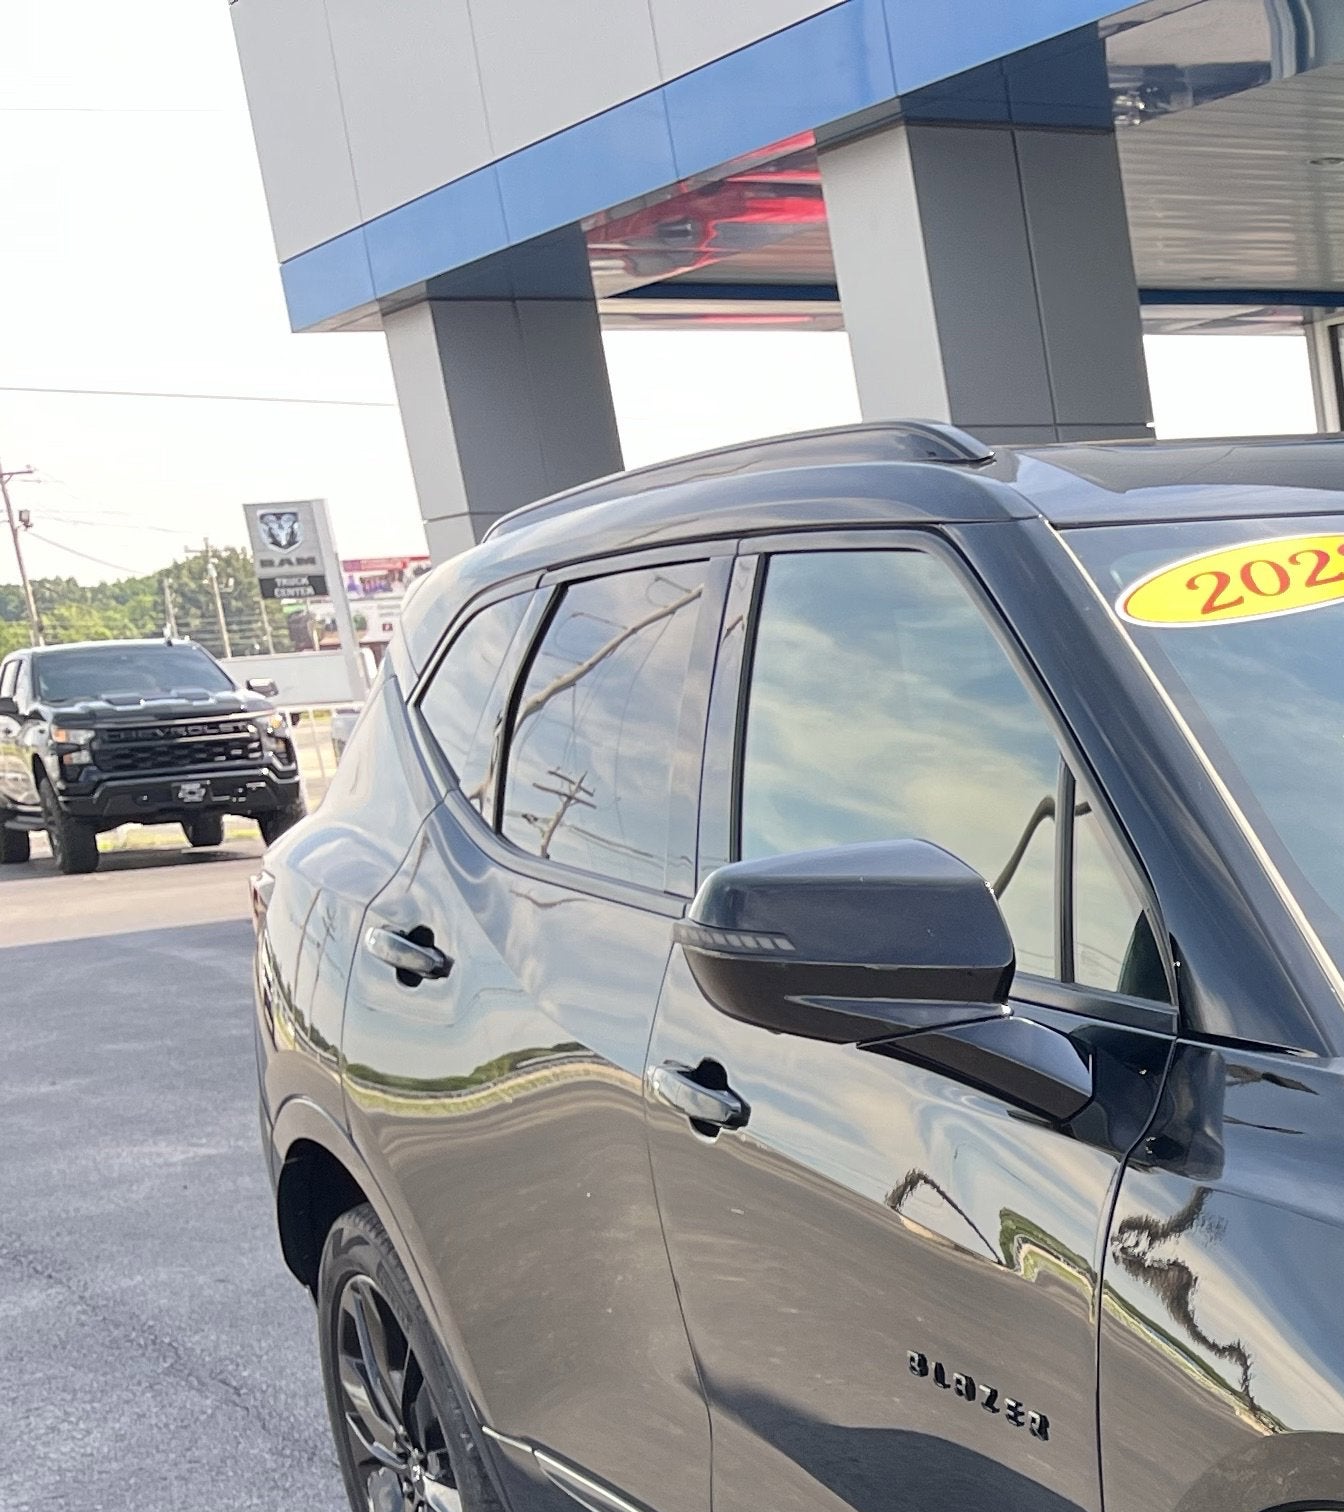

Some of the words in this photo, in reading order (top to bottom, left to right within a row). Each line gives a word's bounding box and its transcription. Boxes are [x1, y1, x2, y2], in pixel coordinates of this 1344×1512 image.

[259, 556, 317, 569] RAM
[274, 577, 310, 587] TRUCK
[273, 587, 316, 598] CENTER
[102, 722, 249, 743] CHEVROLET
[906, 1350, 1050, 1441] BLAZER
